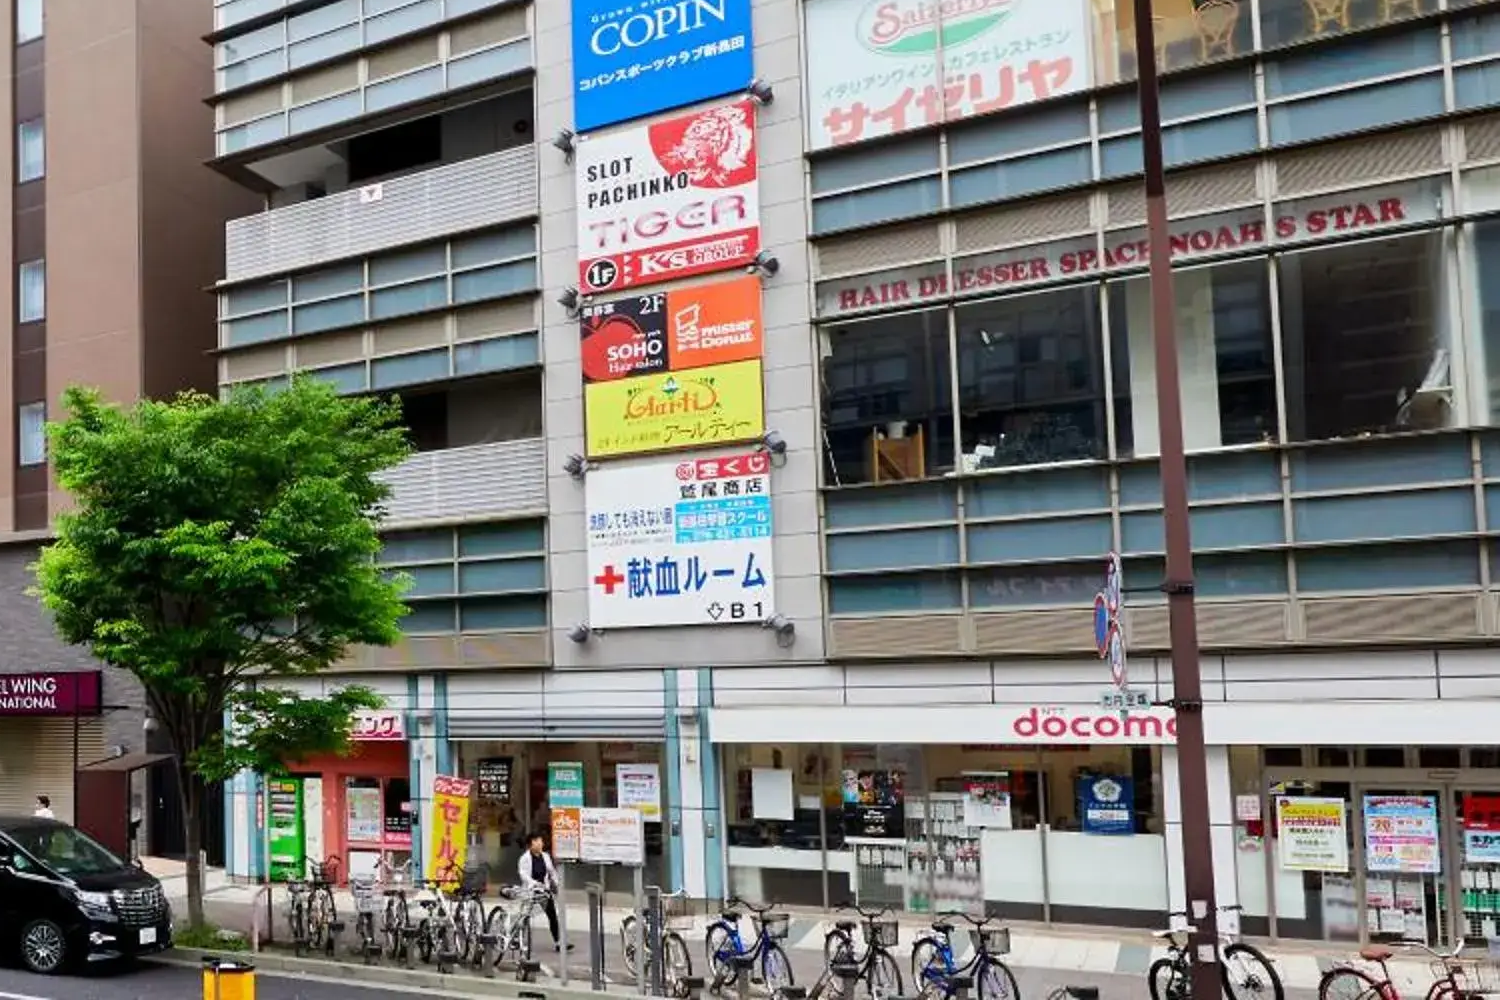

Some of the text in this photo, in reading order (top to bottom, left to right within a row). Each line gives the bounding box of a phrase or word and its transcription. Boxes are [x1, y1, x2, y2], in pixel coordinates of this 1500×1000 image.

[822, 28, 1072, 100] イタリアンワインカフェレストラン
[822, 55, 1074, 146] サイゼリヤ
[586, 156, 635, 183] SLOT
[587, 171, 690, 210] PACHINKO
[588, 194, 747, 249] TIGER
[838, 279, 910, 310] HAIR
[1167, 214, 1297, 253] NOAHS
[1306, 197, 1406, 234] STAR
[591, 262, 615, 286] 1F
[640, 292, 666, 315] 2F
[607, 339, 663, 362] SOHO
[699, 453, 766, 478] 宝くじ
[627, 551, 767, 599] 献血ルーム
[11, 677, 57, 695] WING
